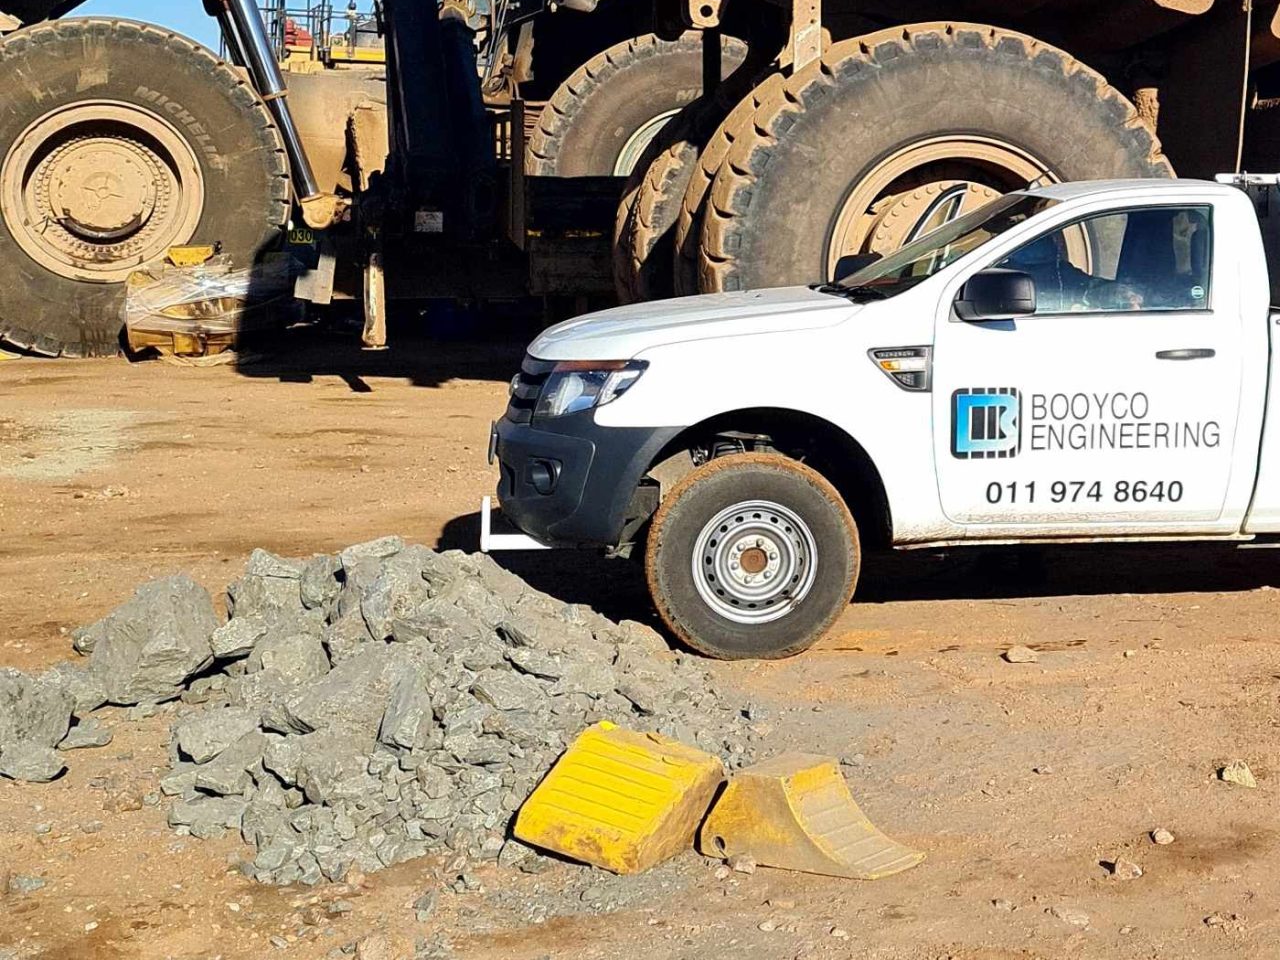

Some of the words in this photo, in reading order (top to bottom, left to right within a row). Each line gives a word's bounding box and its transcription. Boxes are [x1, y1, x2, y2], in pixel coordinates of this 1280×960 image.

[1031, 392, 1149, 421] BOOYCO
[1031, 420, 1221, 451] ENGINEERING
[985, 481, 1036, 504] 011
[1050, 480, 1103, 504] 974
[1113, 480, 1184, 503] 8640
